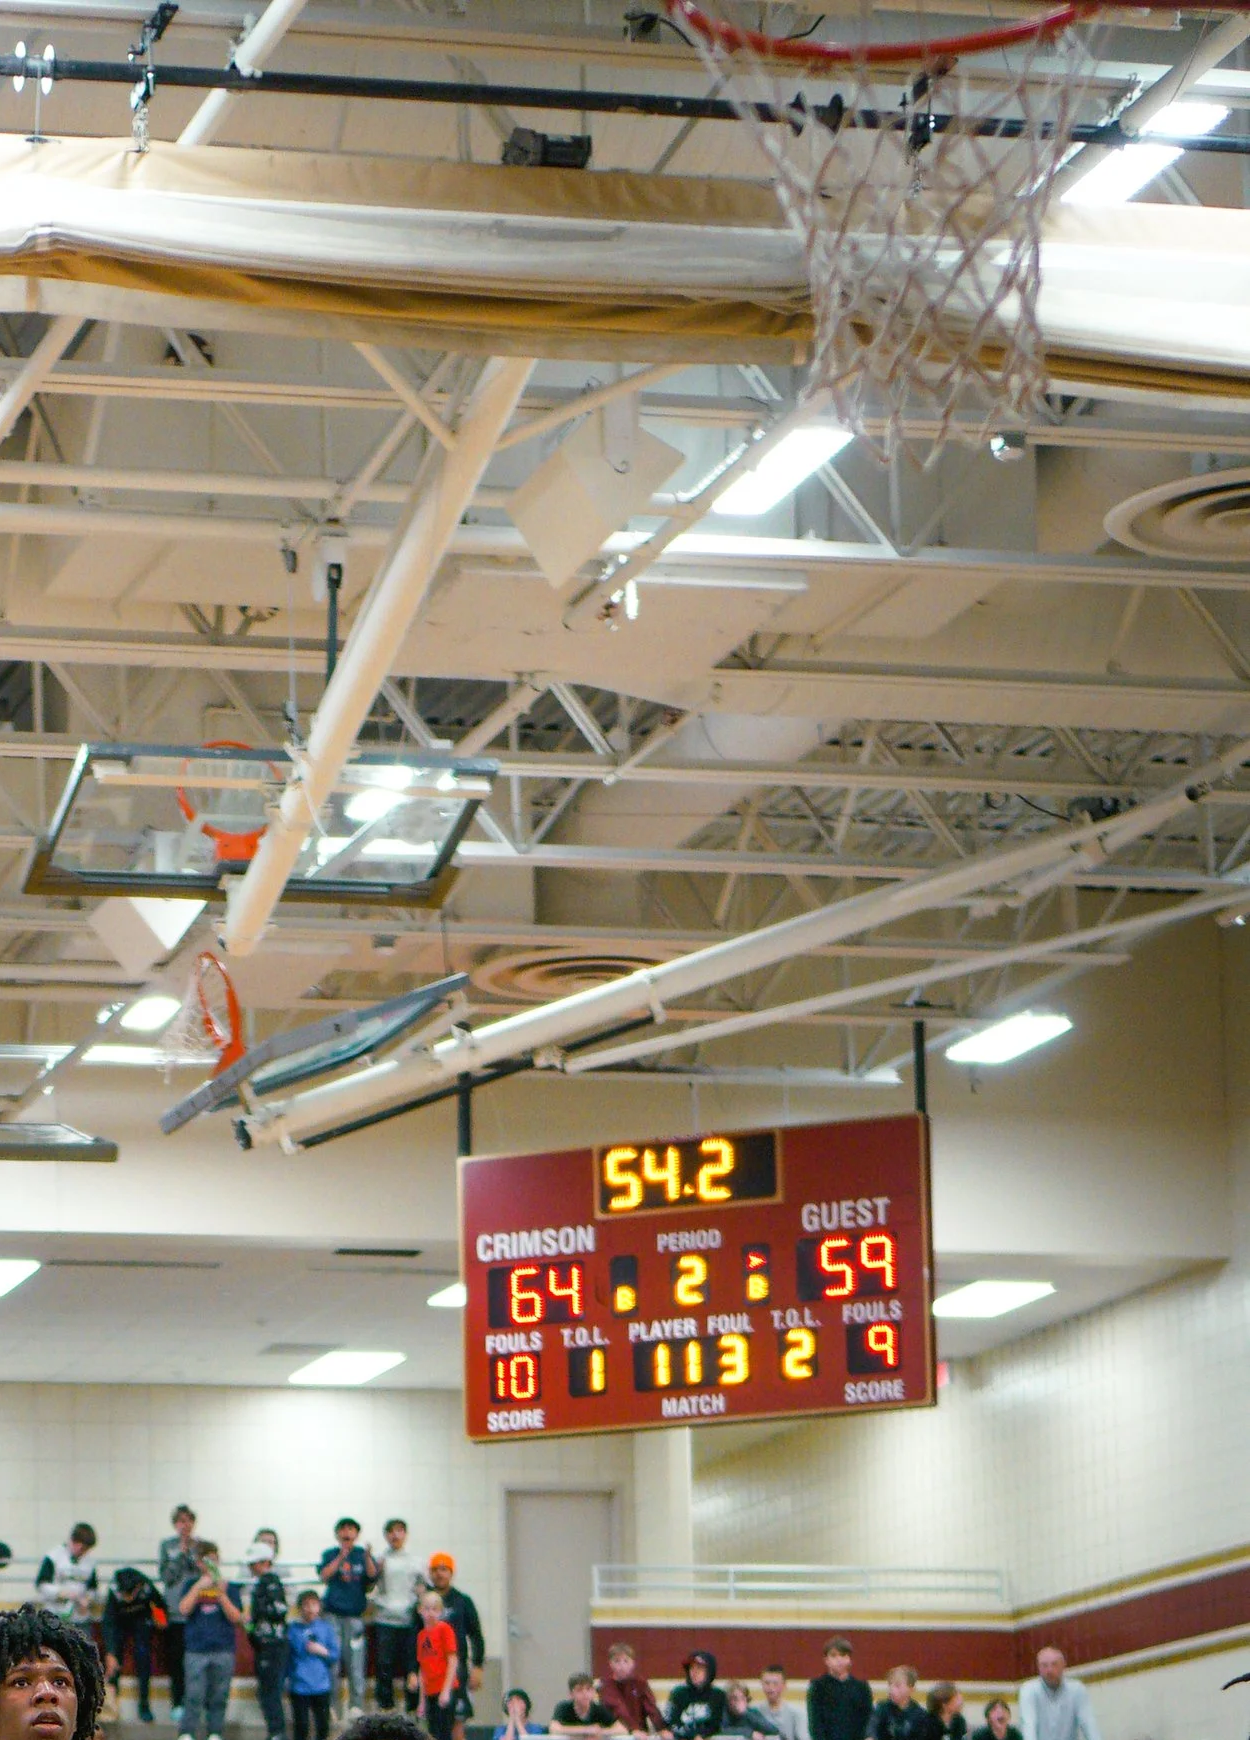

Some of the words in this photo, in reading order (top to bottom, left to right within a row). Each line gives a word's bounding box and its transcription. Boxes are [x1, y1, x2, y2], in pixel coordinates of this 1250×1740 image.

[604, 1137, 735, 1212] 54.2
[802, 1197, 890, 1232] GUEST
[476, 1224, 595, 1262] CRIMSON
[657, 1229, 721, 1252] PERIOD
[675, 1255, 707, 1306] 2
[818, 1233, 897, 1299] 59
[510, 1264, 584, 1325] 64
[842, 1300, 902, 1324] FOULS
[628, 1318, 698, 1343] PLAYER
[707, 1312, 755, 1335] FOUL
[771, 1307, 822, 1329] T.O.L.
[485, 1331, 542, 1354] FOULS
[561, 1326, 610, 1348] T.O.L.
[782, 1328, 815, 1379] 2
[865, 1321, 899, 1368] 9
[496, 1352, 538, 1400] 10
[590, 1349, 605, 1392] 1
[662, 1393, 726, 1417] MATCH
[844, 1379, 904, 1404] SCORE
[487, 1409, 545, 1432] SCORE
